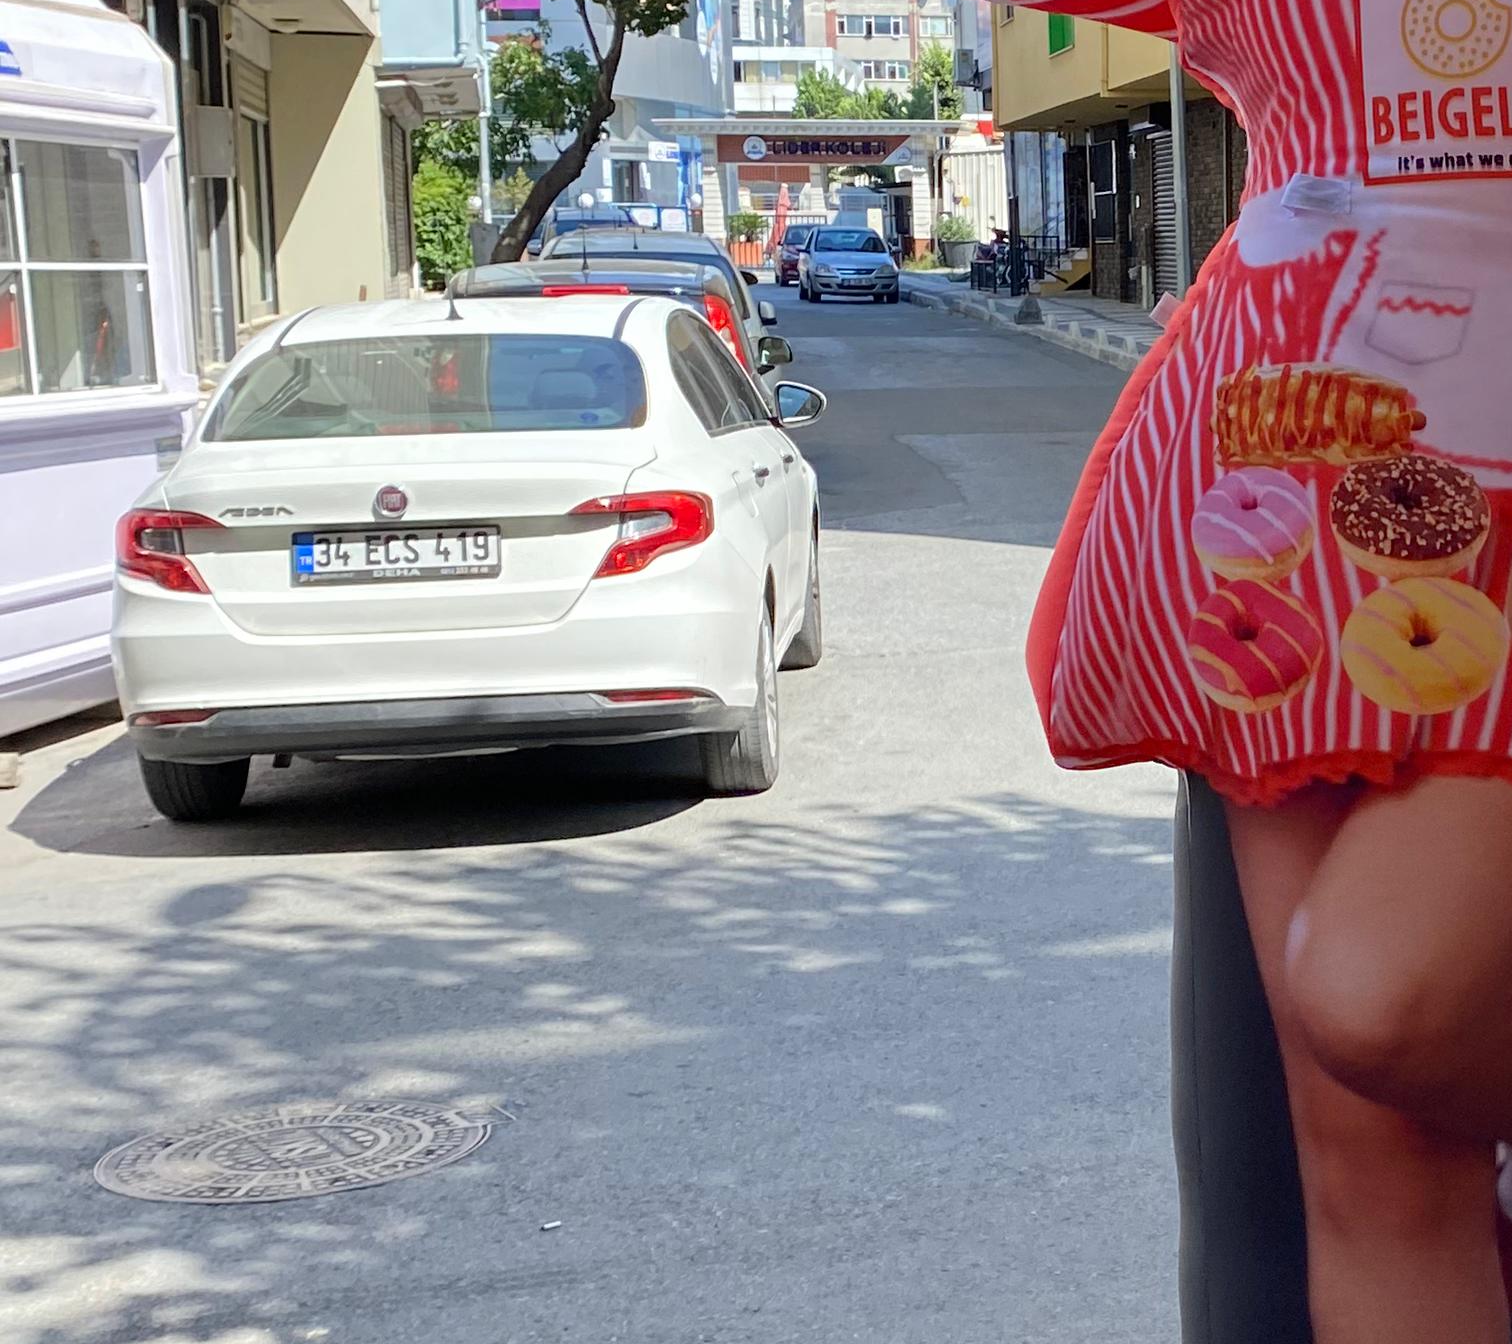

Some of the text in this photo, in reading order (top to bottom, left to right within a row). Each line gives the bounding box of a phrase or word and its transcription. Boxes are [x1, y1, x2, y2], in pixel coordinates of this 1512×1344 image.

[1429, 151, 1474, 170] what
[1478, 153, 1504, 168] we
[315, 530, 489, 568] 34 ECS 419
[299, 556, 313, 567] TR
[372, 567, 422, 578] DEHA
